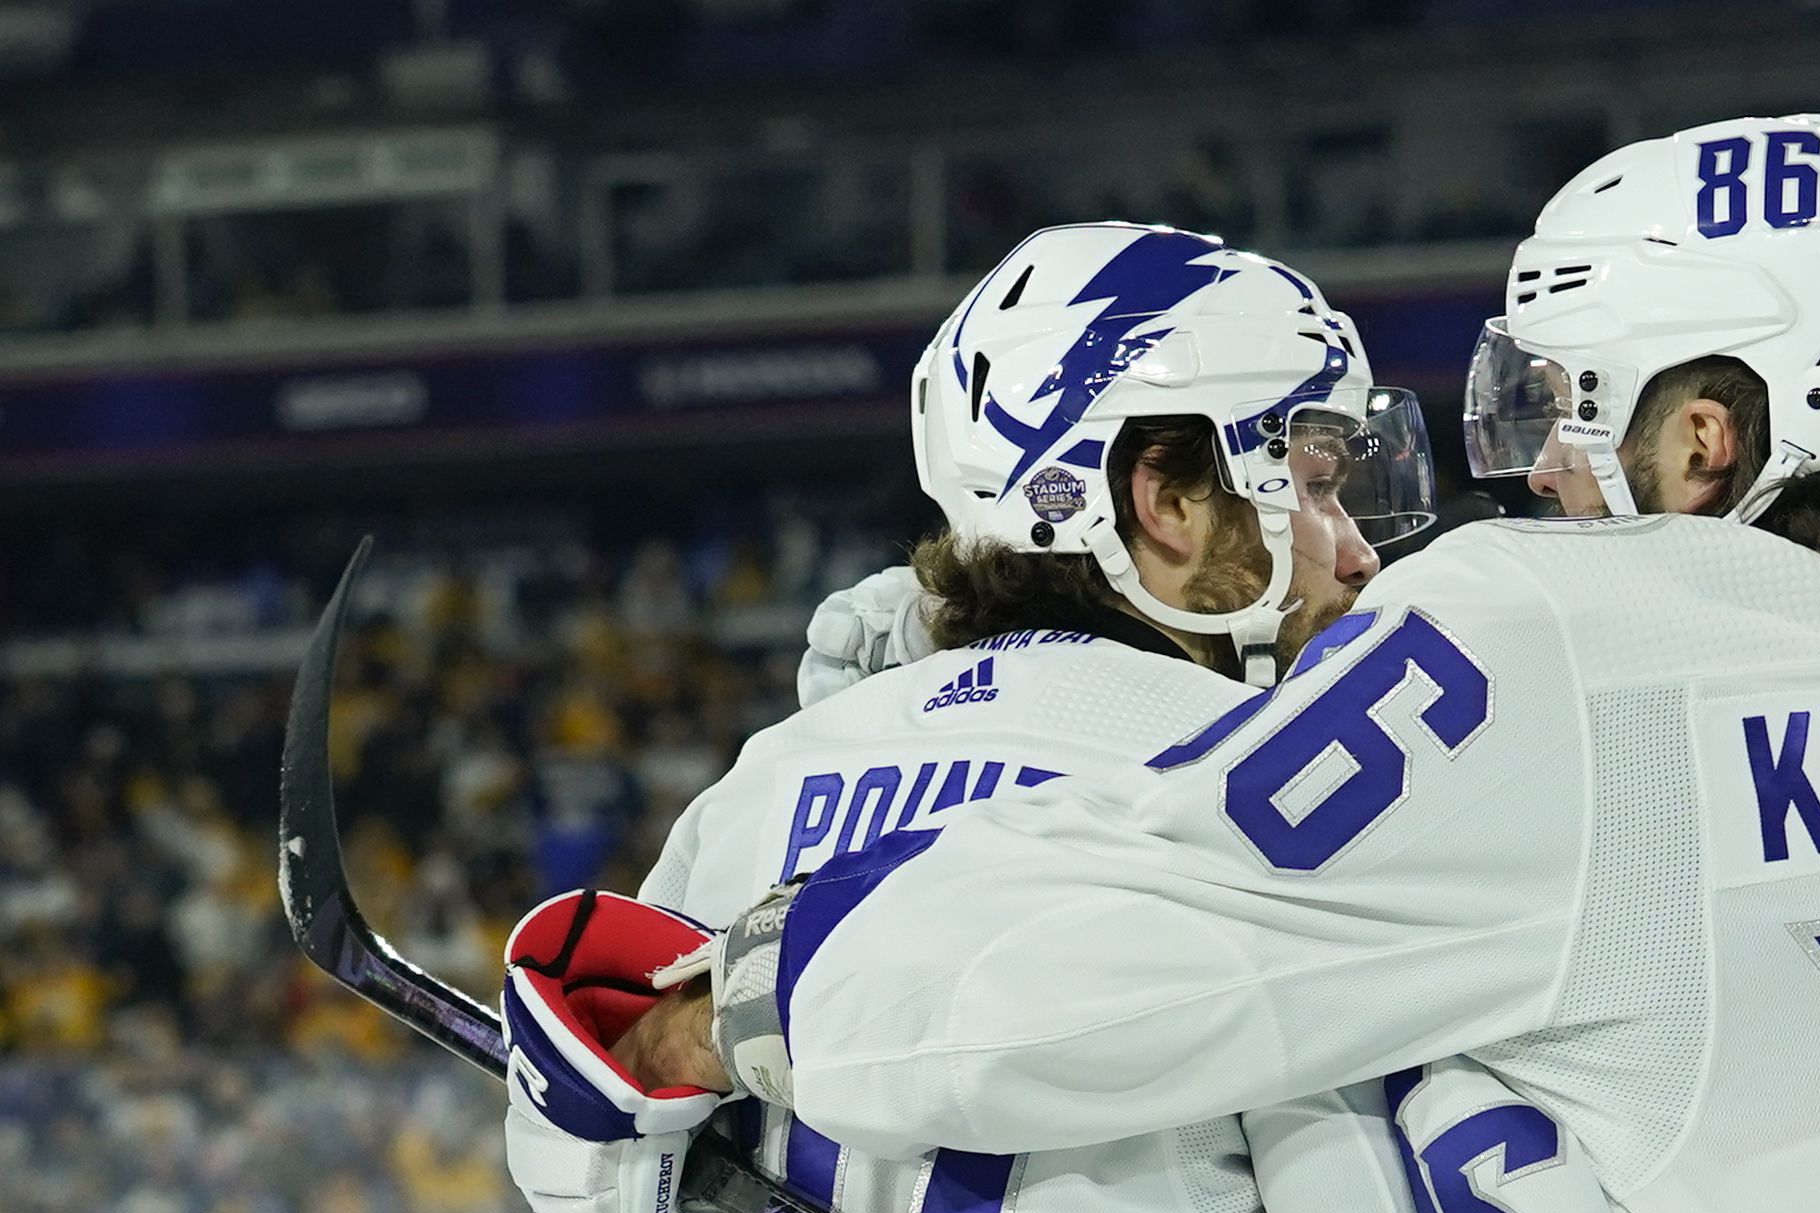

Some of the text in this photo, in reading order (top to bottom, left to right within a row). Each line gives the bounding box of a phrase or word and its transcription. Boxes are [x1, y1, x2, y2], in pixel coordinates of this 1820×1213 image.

[1561, 423, 1611, 438] BAUER
[1023, 480, 1085, 498] STADIUM
[923, 686, 999, 713] adidas
